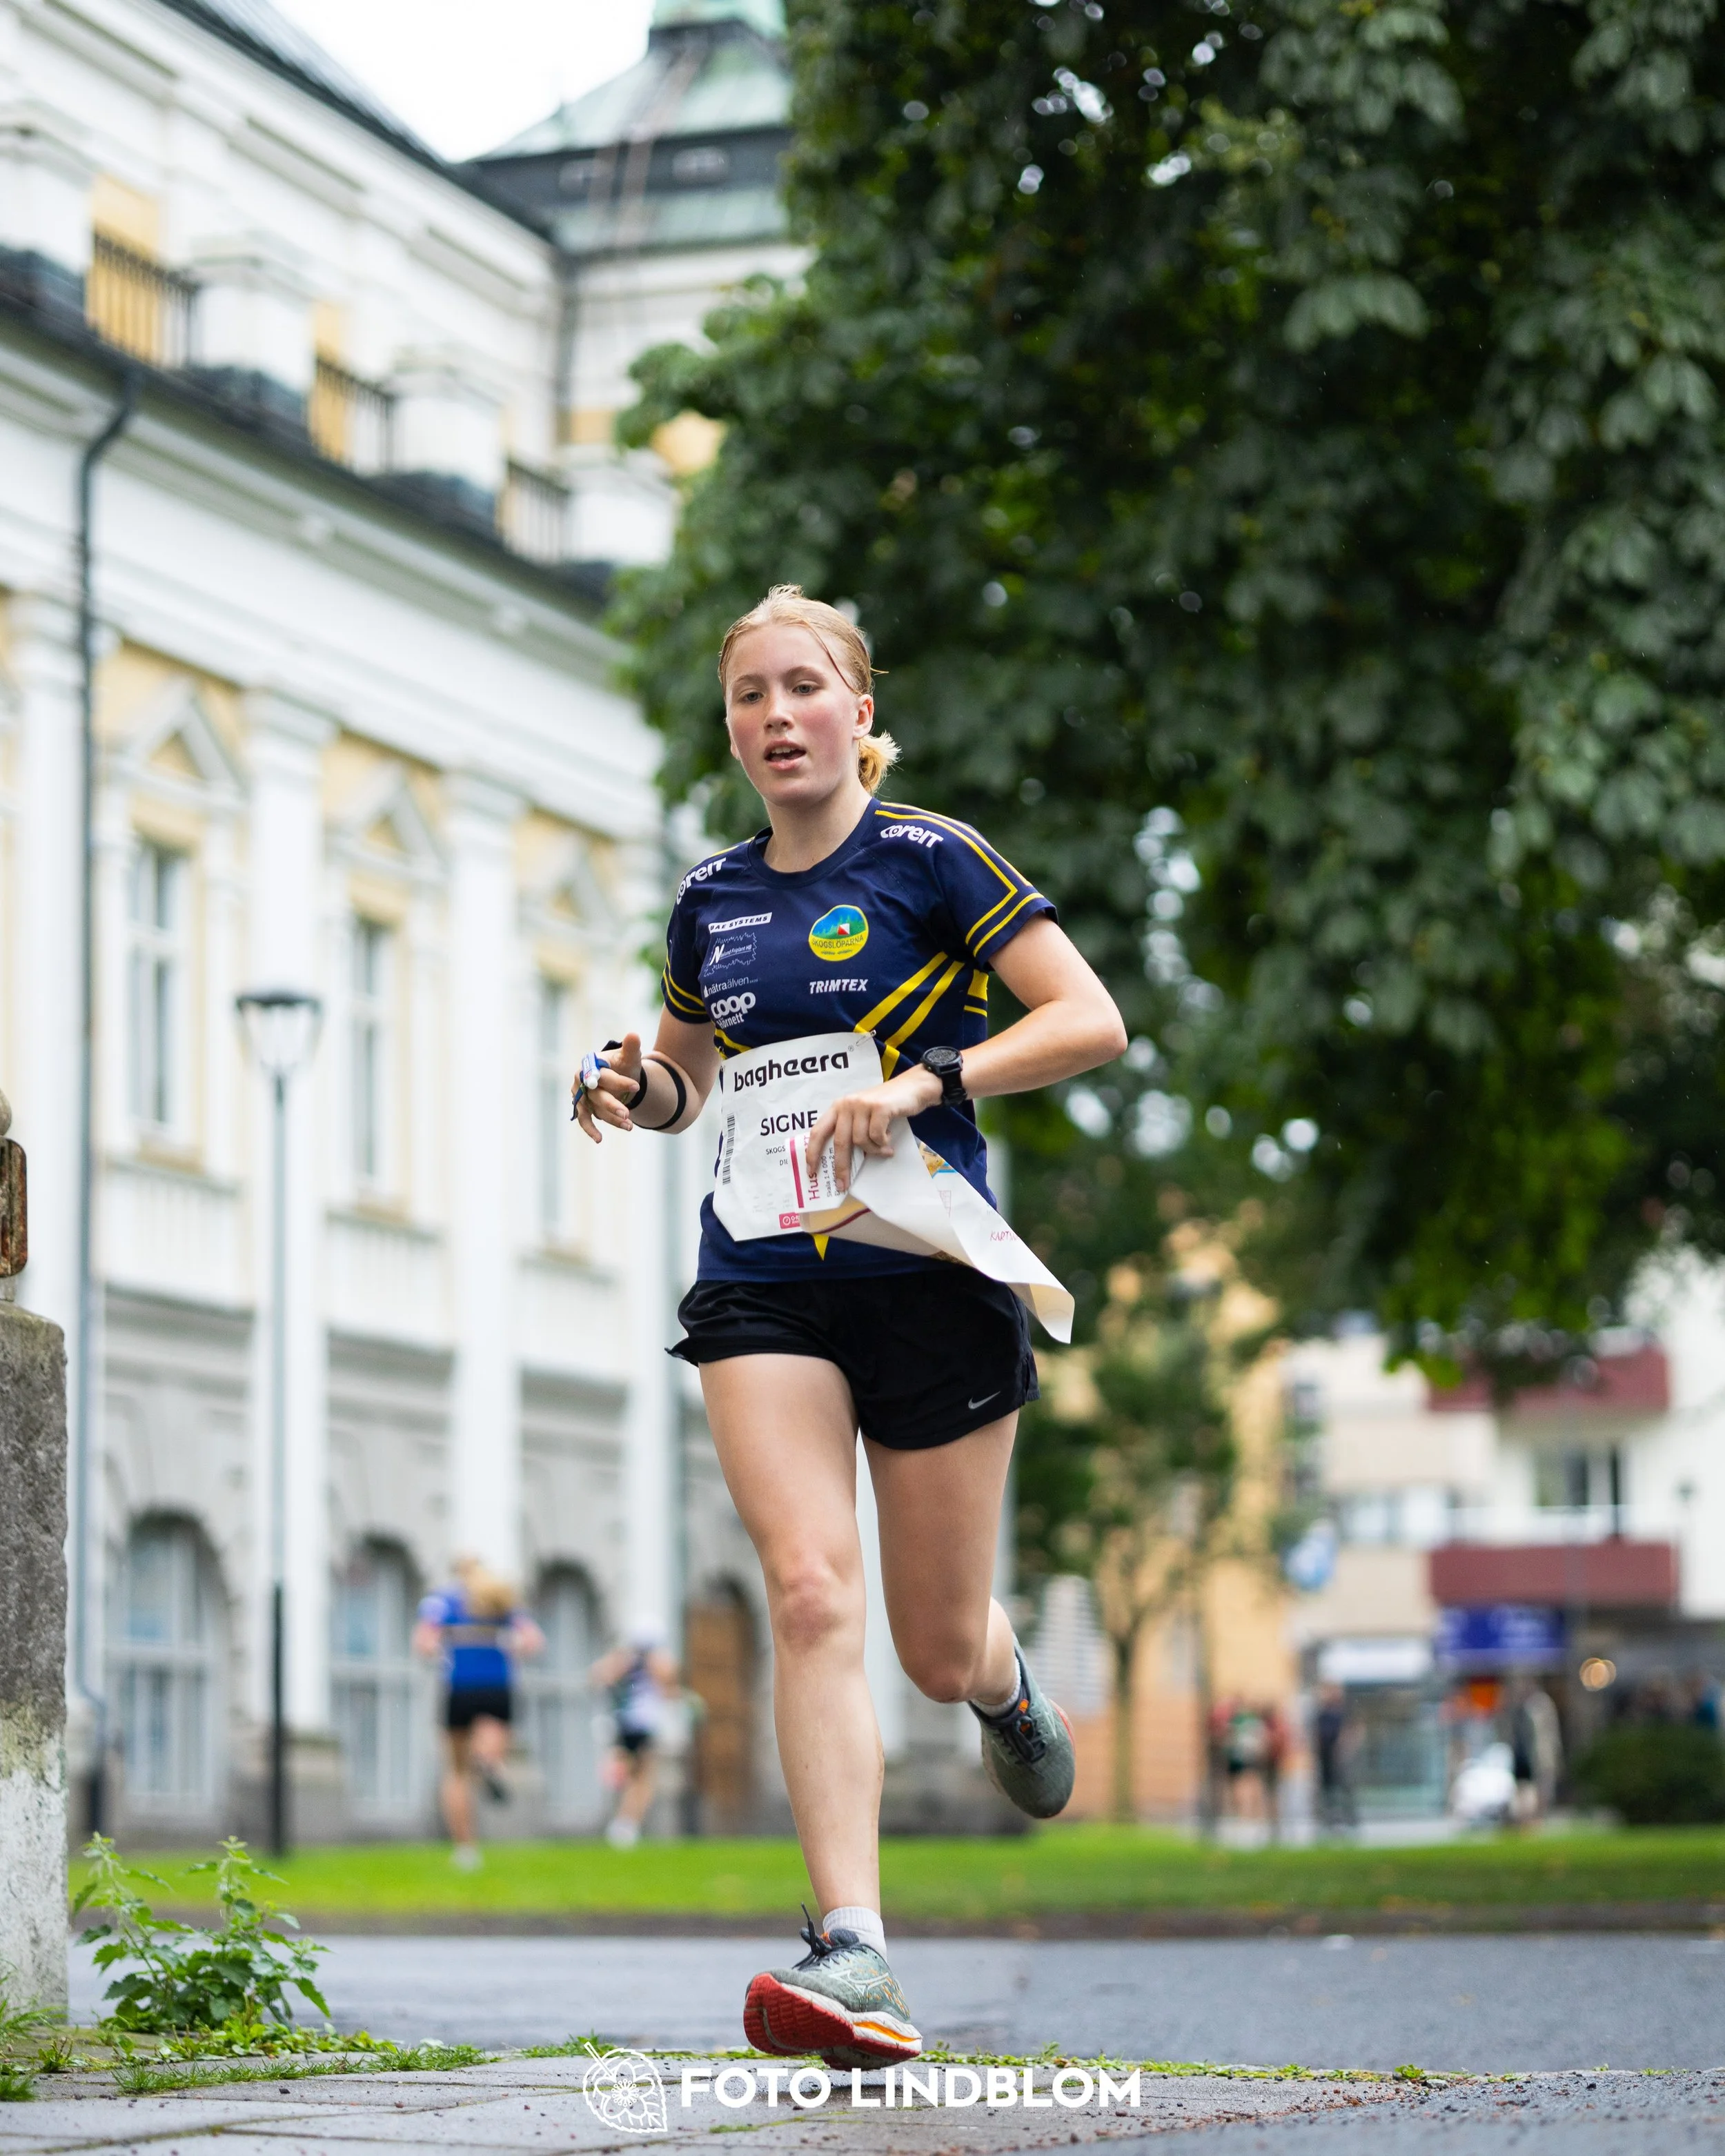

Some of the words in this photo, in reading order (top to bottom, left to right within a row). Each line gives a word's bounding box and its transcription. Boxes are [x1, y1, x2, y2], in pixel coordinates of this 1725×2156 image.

[729, 916, 768, 928] SYSTEMS
[809, 979, 868, 993] TRIMTEX
[711, 991, 756, 1019] coop
[716, 1012, 745, 1029] Hörnett
[760, 1109, 818, 1136] SIGNE
[766, 1145, 786, 1155] SKOGS
